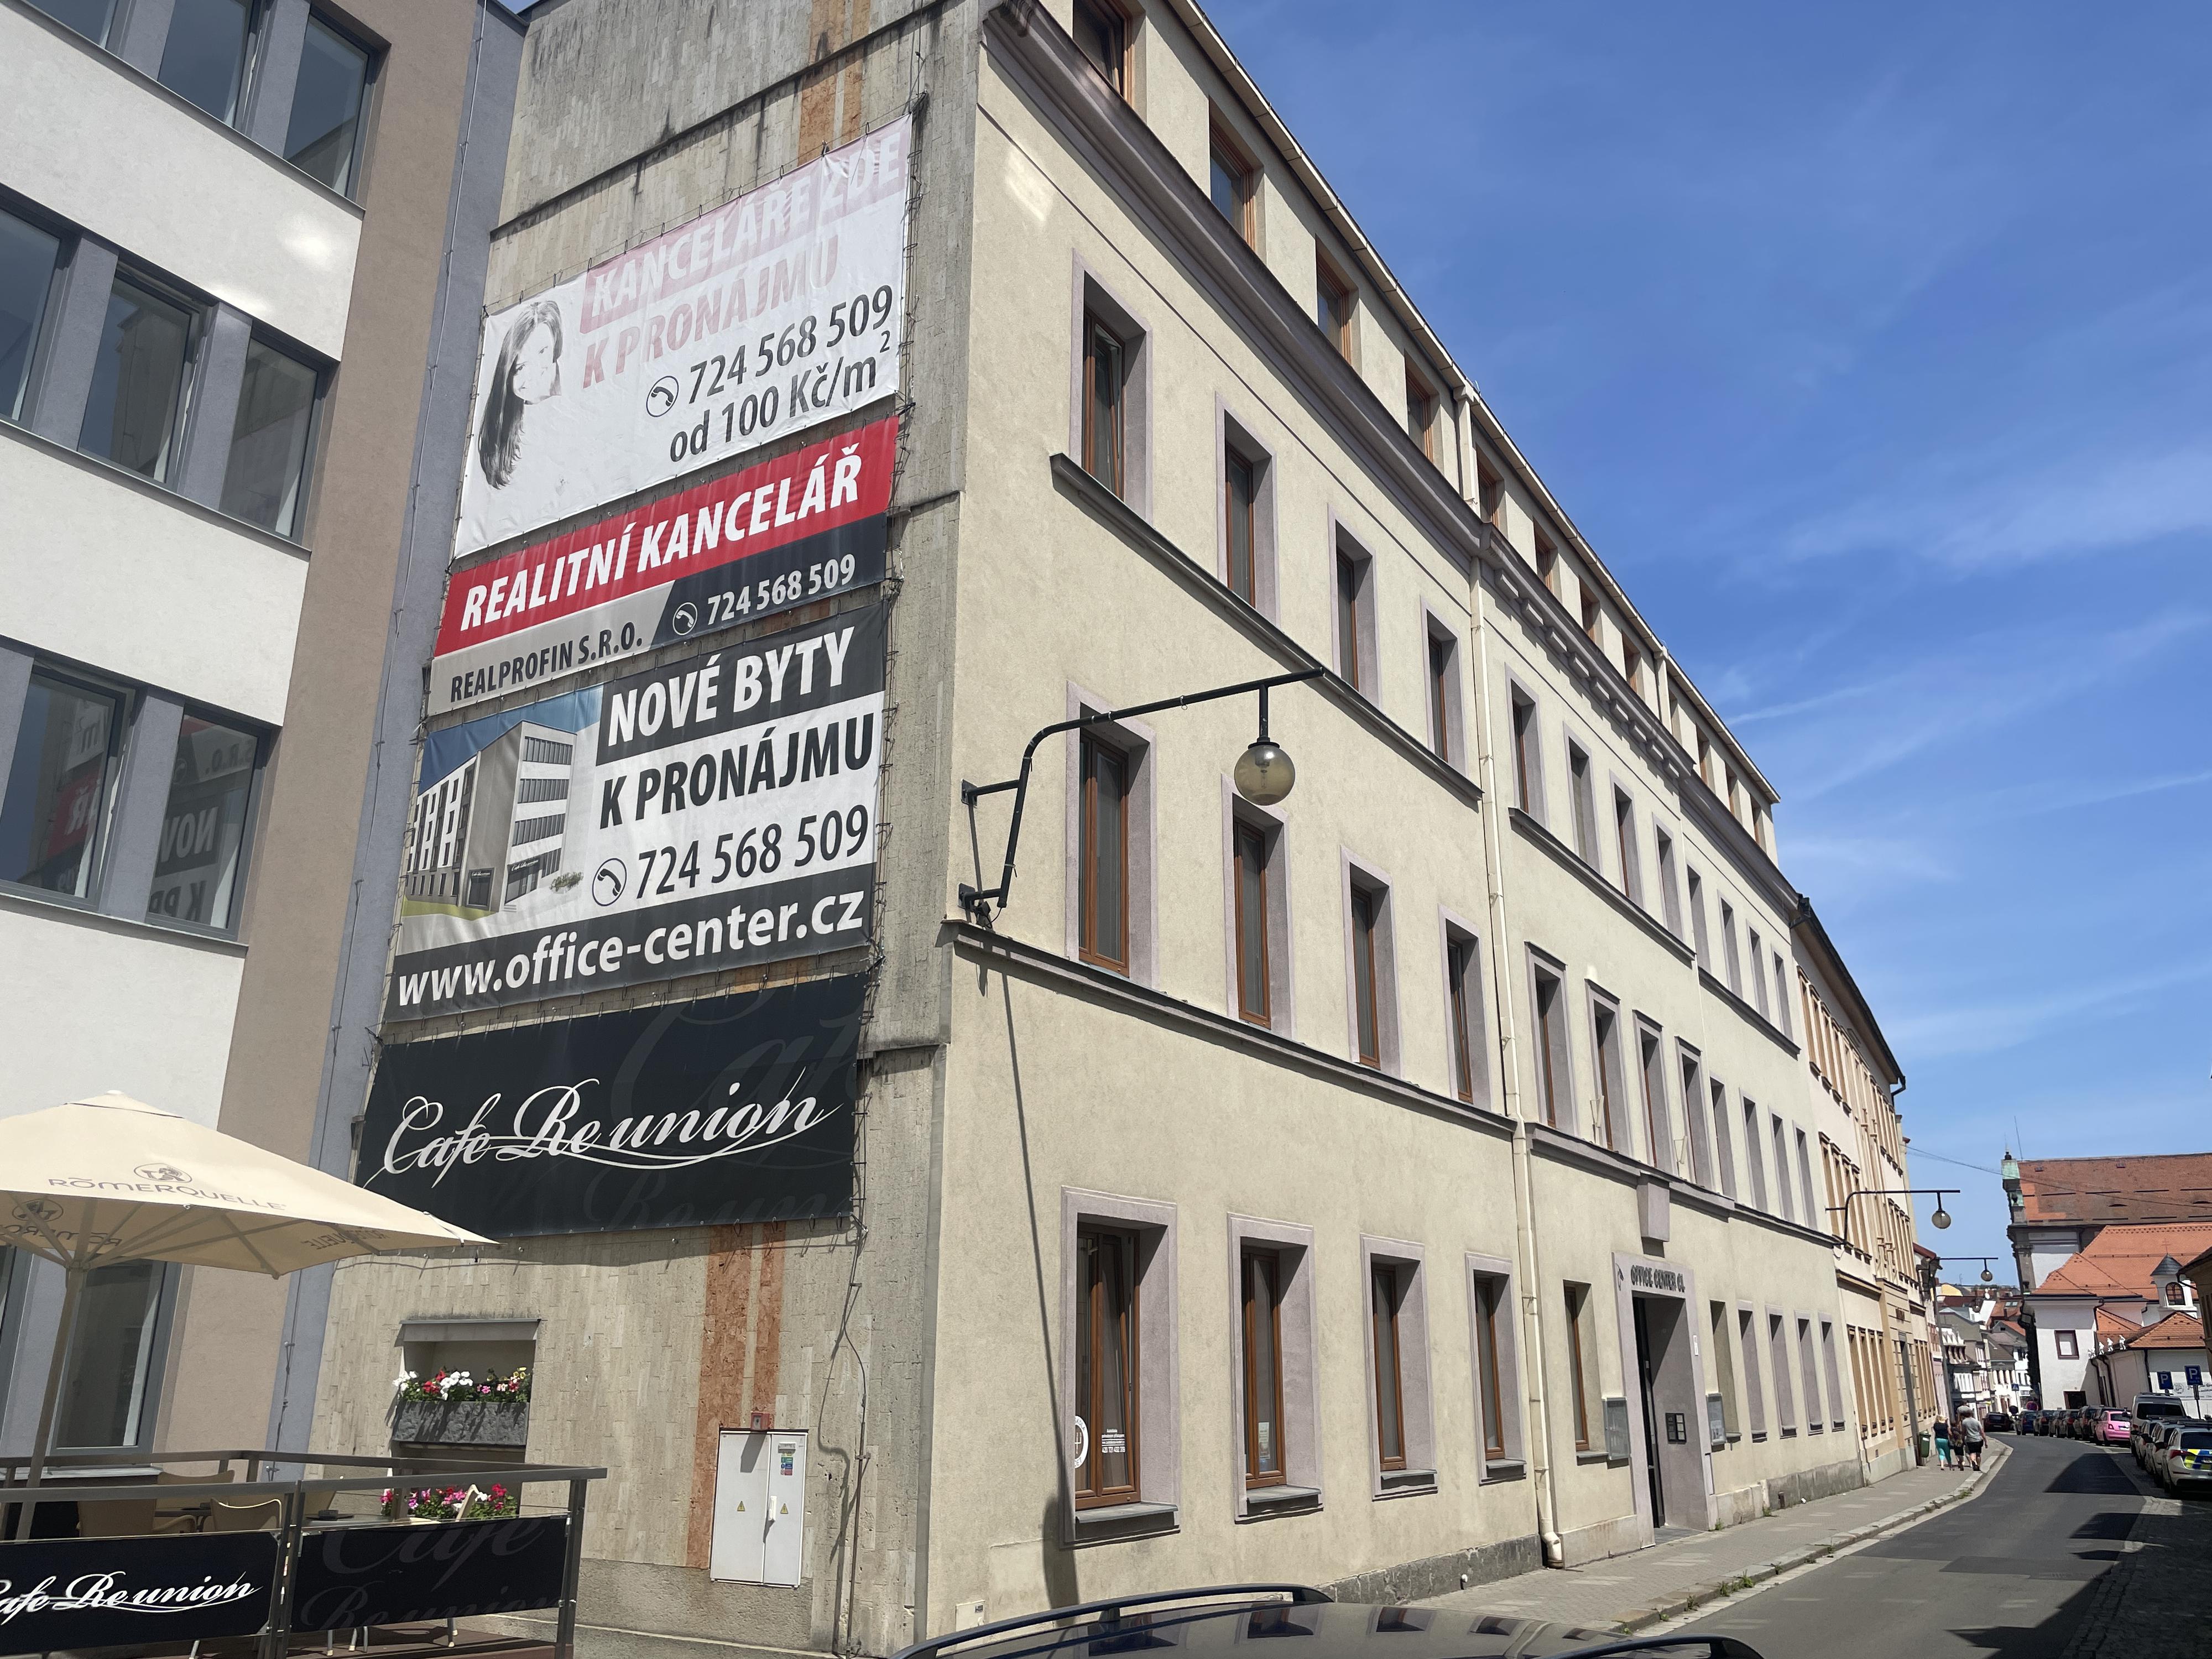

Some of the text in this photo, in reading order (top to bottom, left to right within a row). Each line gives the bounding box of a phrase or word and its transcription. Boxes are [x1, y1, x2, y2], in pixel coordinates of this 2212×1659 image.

[590, 131, 902, 317] KANCELÁŘE ZDE
[583, 234, 839, 389] K PRONÁJMU
[689, 285, 893, 404] 724 568 509
[671, 419, 708, 462] od
[722, 387, 779, 444] 100
[461, 442, 860, 631] REALITNÍ KANCELÁŘ
[707, 555, 855, 625] 724 568 509
[451, 622, 643, 702] REALPROFIN S.R.O.
[608, 626, 855, 747] NOVÉ BYTY
[600, 713, 873, 830] K PRONÁJMU
[637, 805, 869, 899] 724 568 509
[399, 890, 865, 1006] www.office-center.cz
[382, 1067, 835, 1189] Cafe Reunion
[52, 1571, 263, 1613] Reunion
